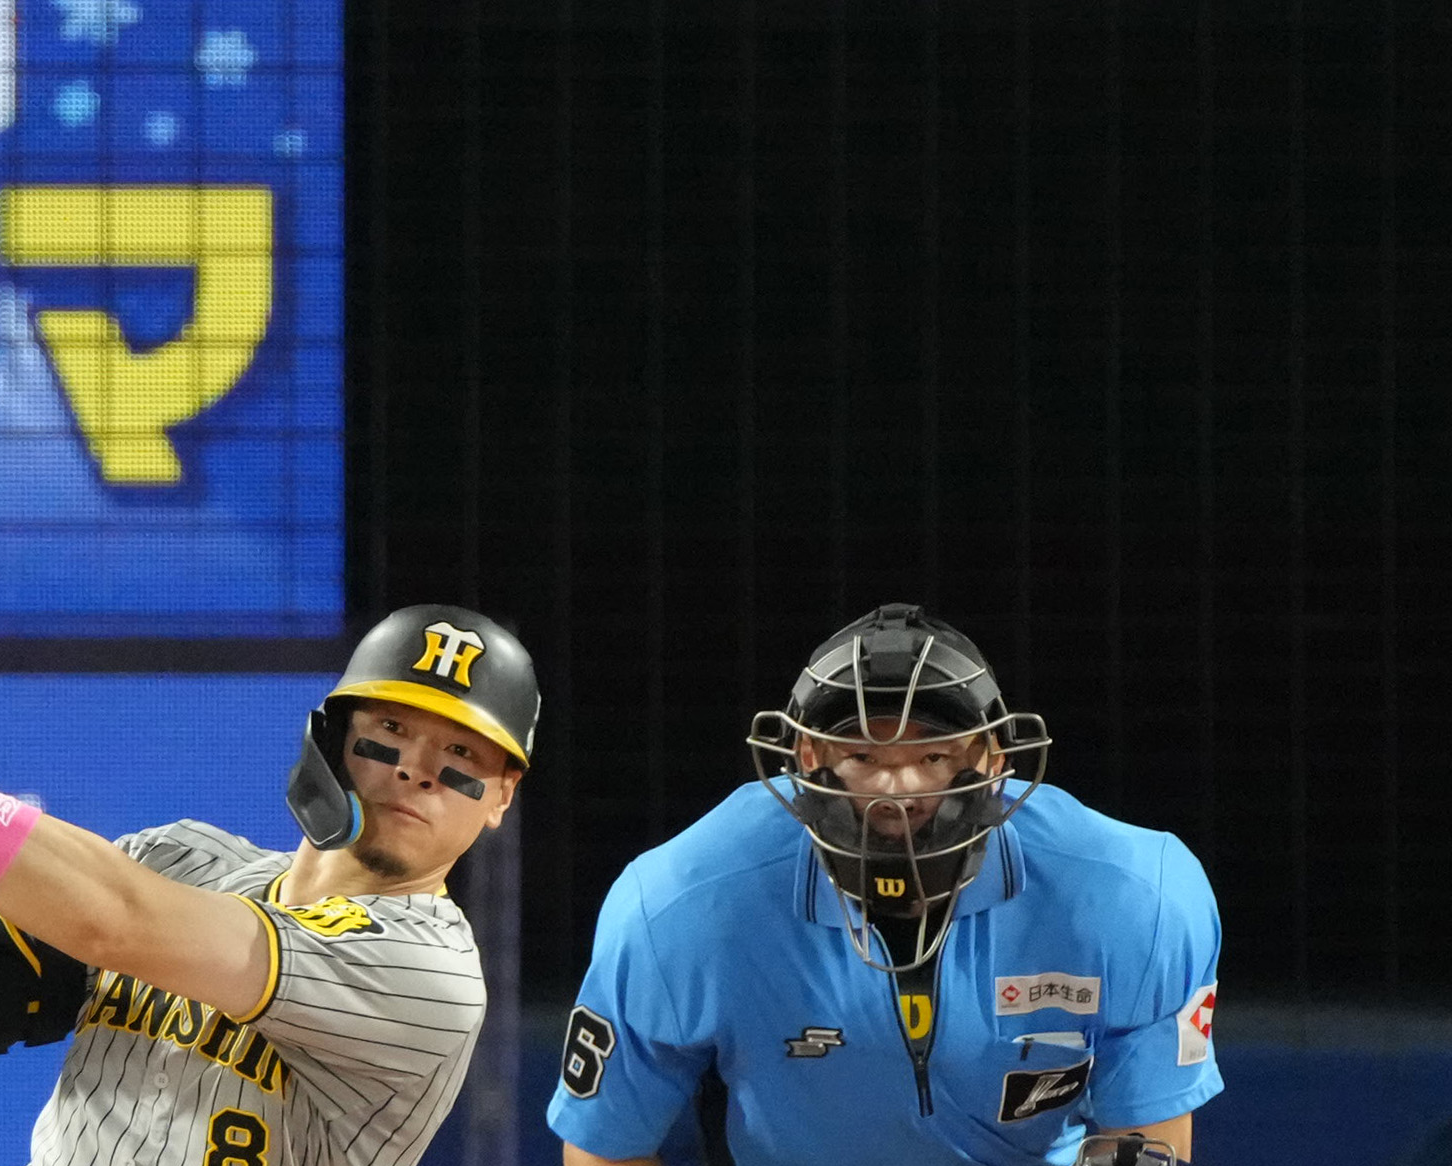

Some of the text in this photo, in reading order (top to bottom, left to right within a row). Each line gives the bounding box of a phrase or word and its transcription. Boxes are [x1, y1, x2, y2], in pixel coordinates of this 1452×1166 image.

[1028, 983, 1094, 1005] 日本生命
[560, 1004, 617, 1099] 6
